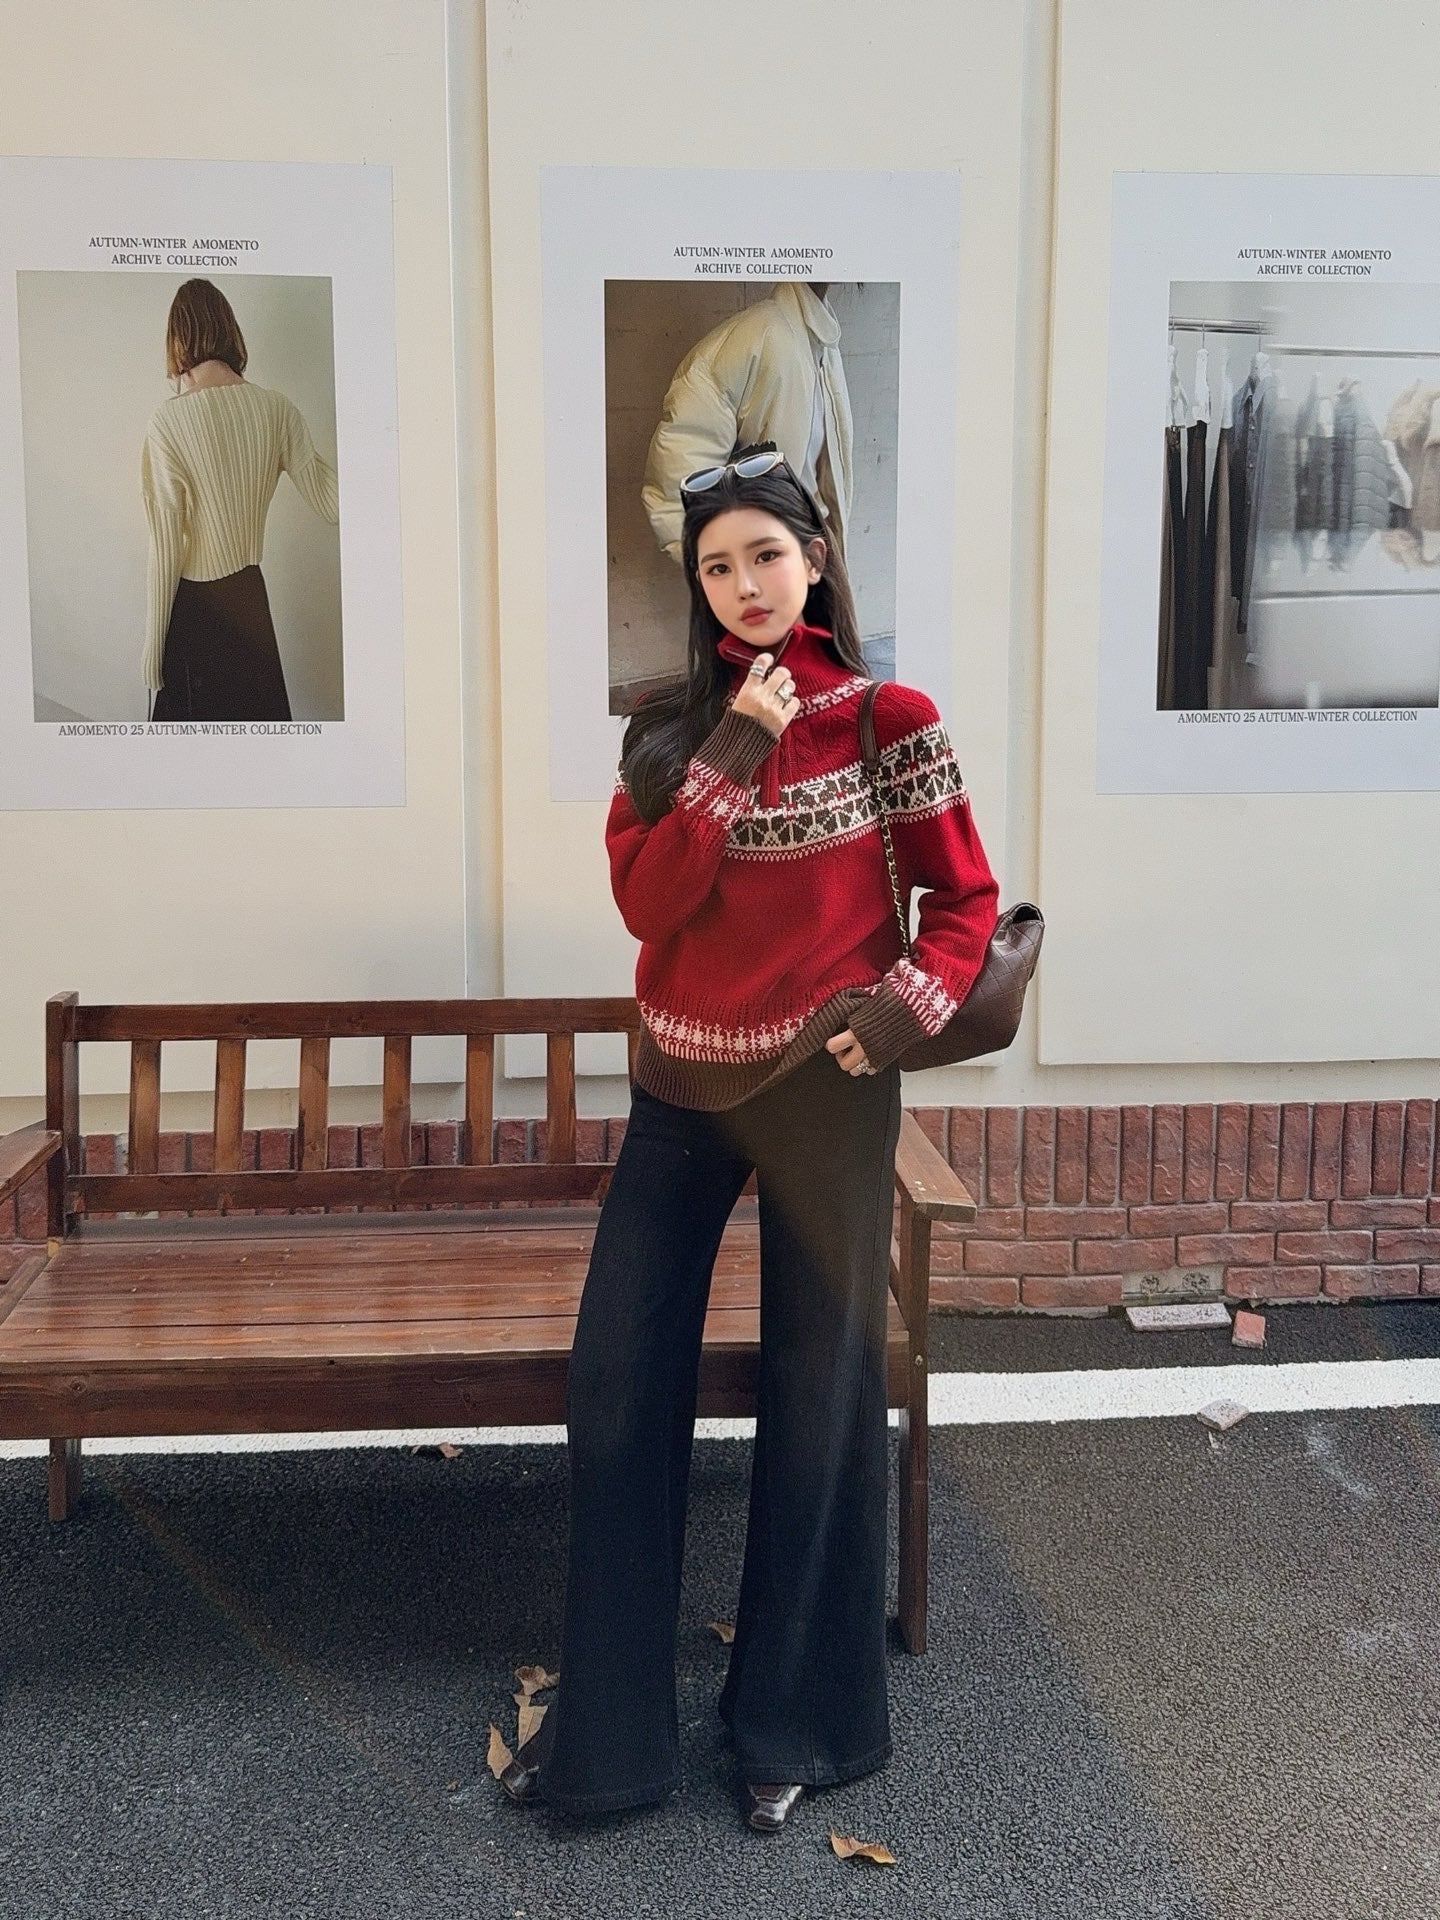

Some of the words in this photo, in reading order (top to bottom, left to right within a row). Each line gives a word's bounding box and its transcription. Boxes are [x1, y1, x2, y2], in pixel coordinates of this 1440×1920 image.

[88, 236, 188, 249] AUTUMN-WINTER
[191, 238, 260, 251] AMOMENTO
[673, 246, 767, 258] AUTUMN-WINTER
[770, 247, 834, 259] AMOMENTO
[1237, 248, 1327, 260] AUTUMN-WINTER
[1330, 249, 1392, 261] AMOMENTO
[111, 253, 163, 265] ARCHIVE
[166, 254, 238, 267] COLLECTION
[694, 262, 742, 274] ARCHIVE
[745, 263, 813, 275] COLLECTION
[1256, 264, 1304, 275] ARCHIVE
[1307, 264, 1372, 276] COLLECTION
[1177, 711, 1241, 724] AMOMENTO
[1242, 711, 1256, 723] 25
[1257, 710, 1350, 723] AUTUMN-WINTER
[1351, 709, 1418, 722] COLLECTION
[57, 724, 128, 737] AMOMENTO
[130, 724, 145, 736] 25
[146, 723, 248, 736] AUTUMN-WINTER
[250, 723, 323, 736] COLLECTION
